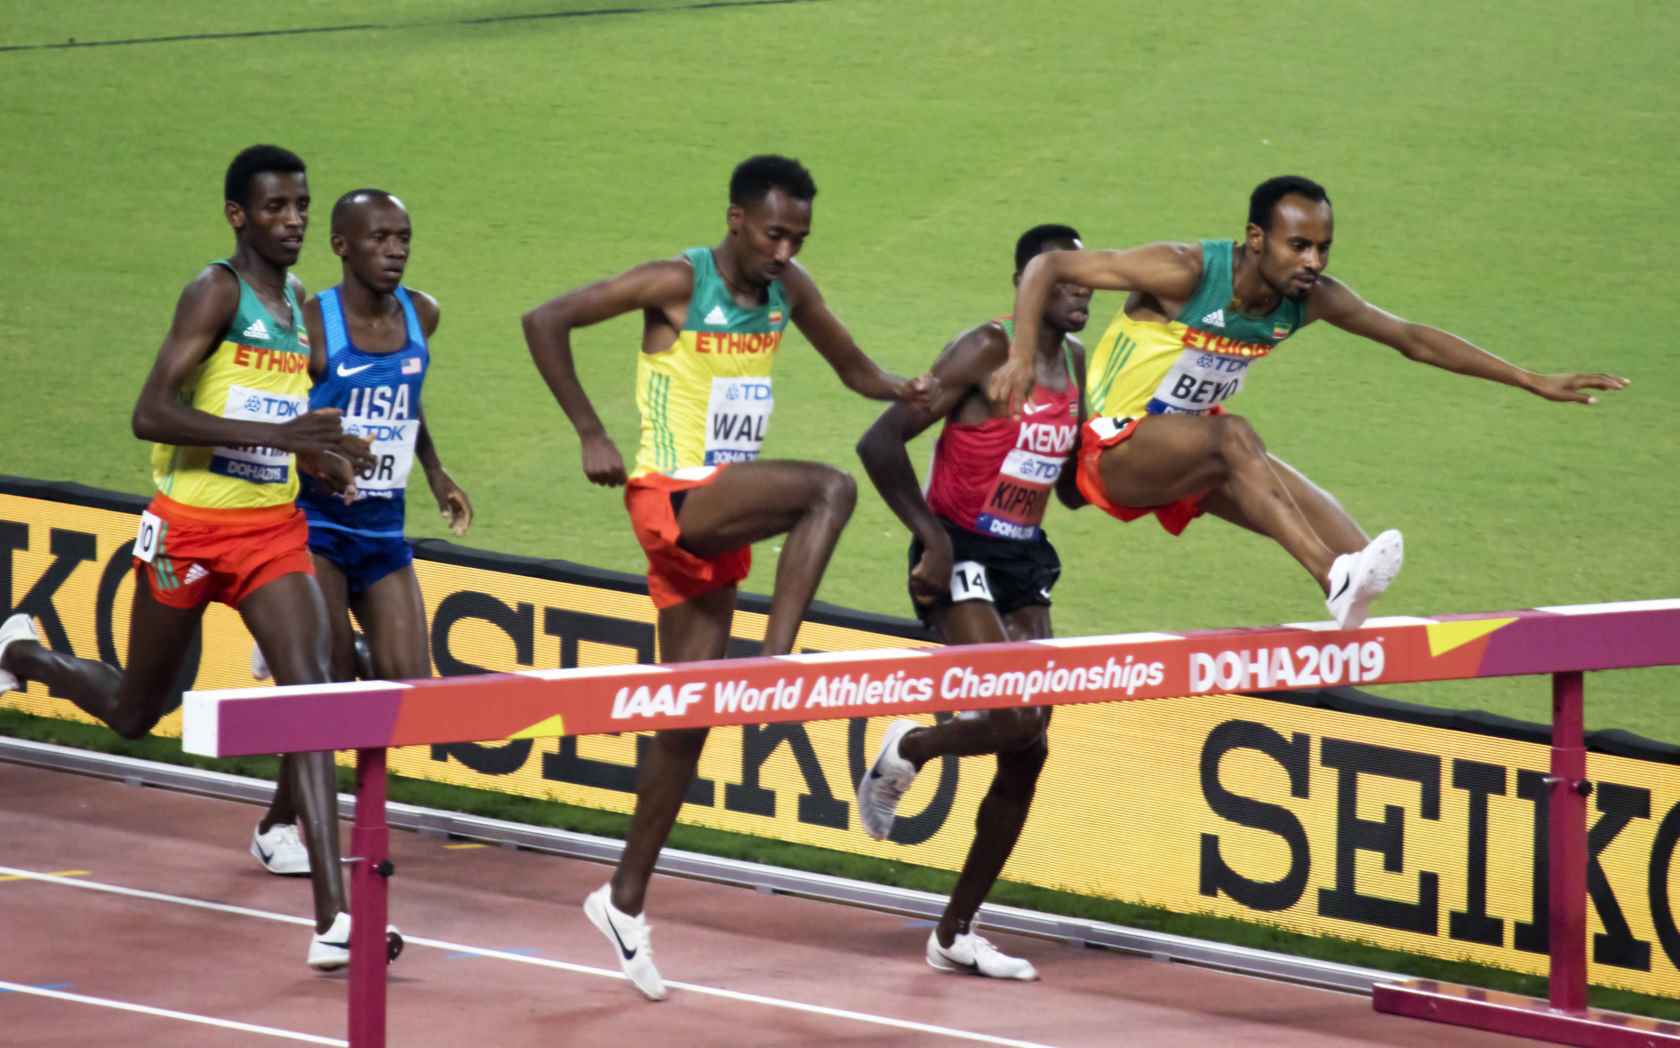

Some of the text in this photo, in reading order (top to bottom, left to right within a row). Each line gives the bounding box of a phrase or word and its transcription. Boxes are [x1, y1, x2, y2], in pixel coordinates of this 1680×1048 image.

[262, 398, 300, 416] TDK
[346, 384, 409, 420] USA
[362, 425, 407, 441] TDK
[713, 413, 765, 442] WAL
[955, 569, 986, 593] 14
[611, 640, 1385, 719] IAAF World Athletics Championships DOHA2019
